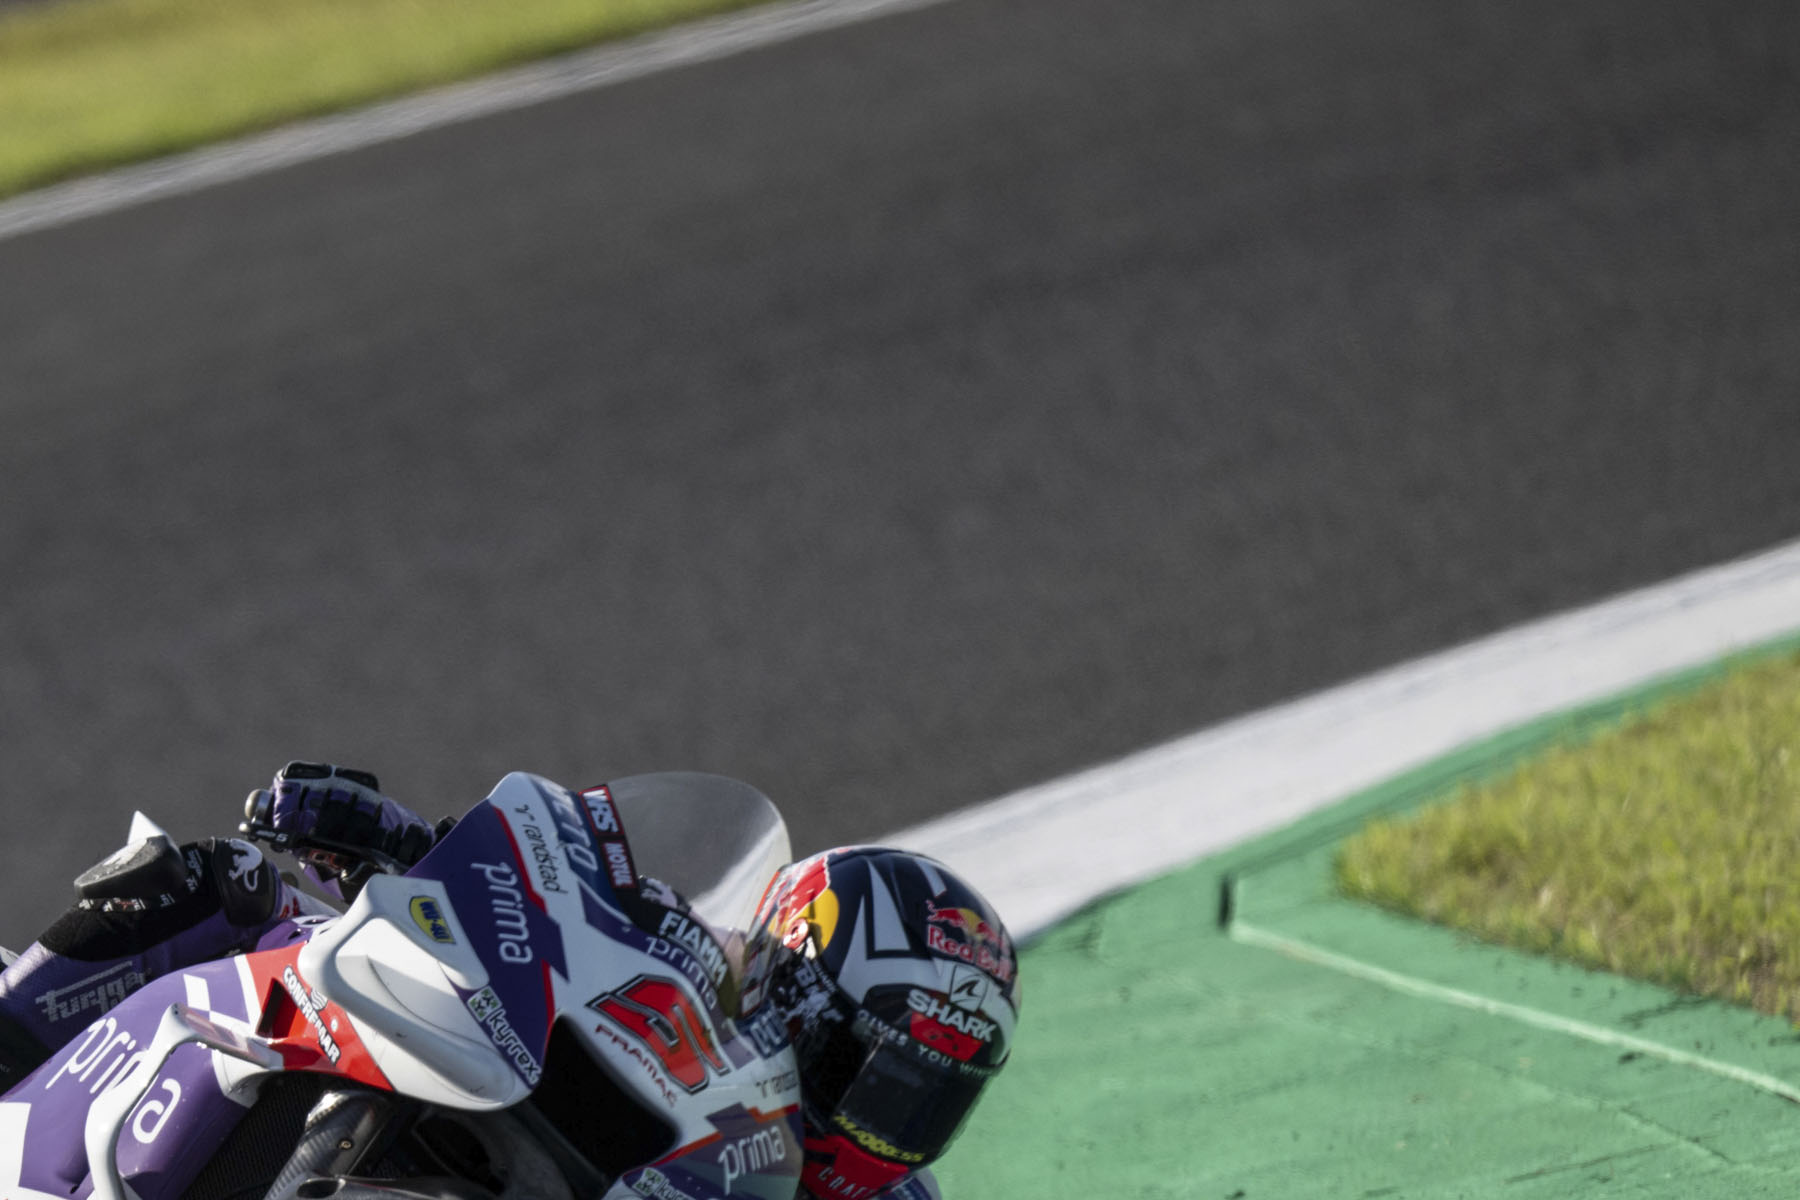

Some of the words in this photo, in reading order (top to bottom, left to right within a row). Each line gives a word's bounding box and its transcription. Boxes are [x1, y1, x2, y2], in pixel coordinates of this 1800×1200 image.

[522, 824, 569, 894] randstad
[605, 842, 633, 886] MOTUL
[470, 862, 533, 964] prima
[927, 924, 973, 961] Red
[645, 937, 717, 1009] prima
[659, 911, 728, 987] FIAMM
[486, 1008, 542, 1085] kyrrex
[907, 988, 998, 1042] SHARK
[595, 1024, 678, 1105] PRAMAC
[917, 1044, 953, 1067] YOU
[718, 1126, 785, 1195] prima
